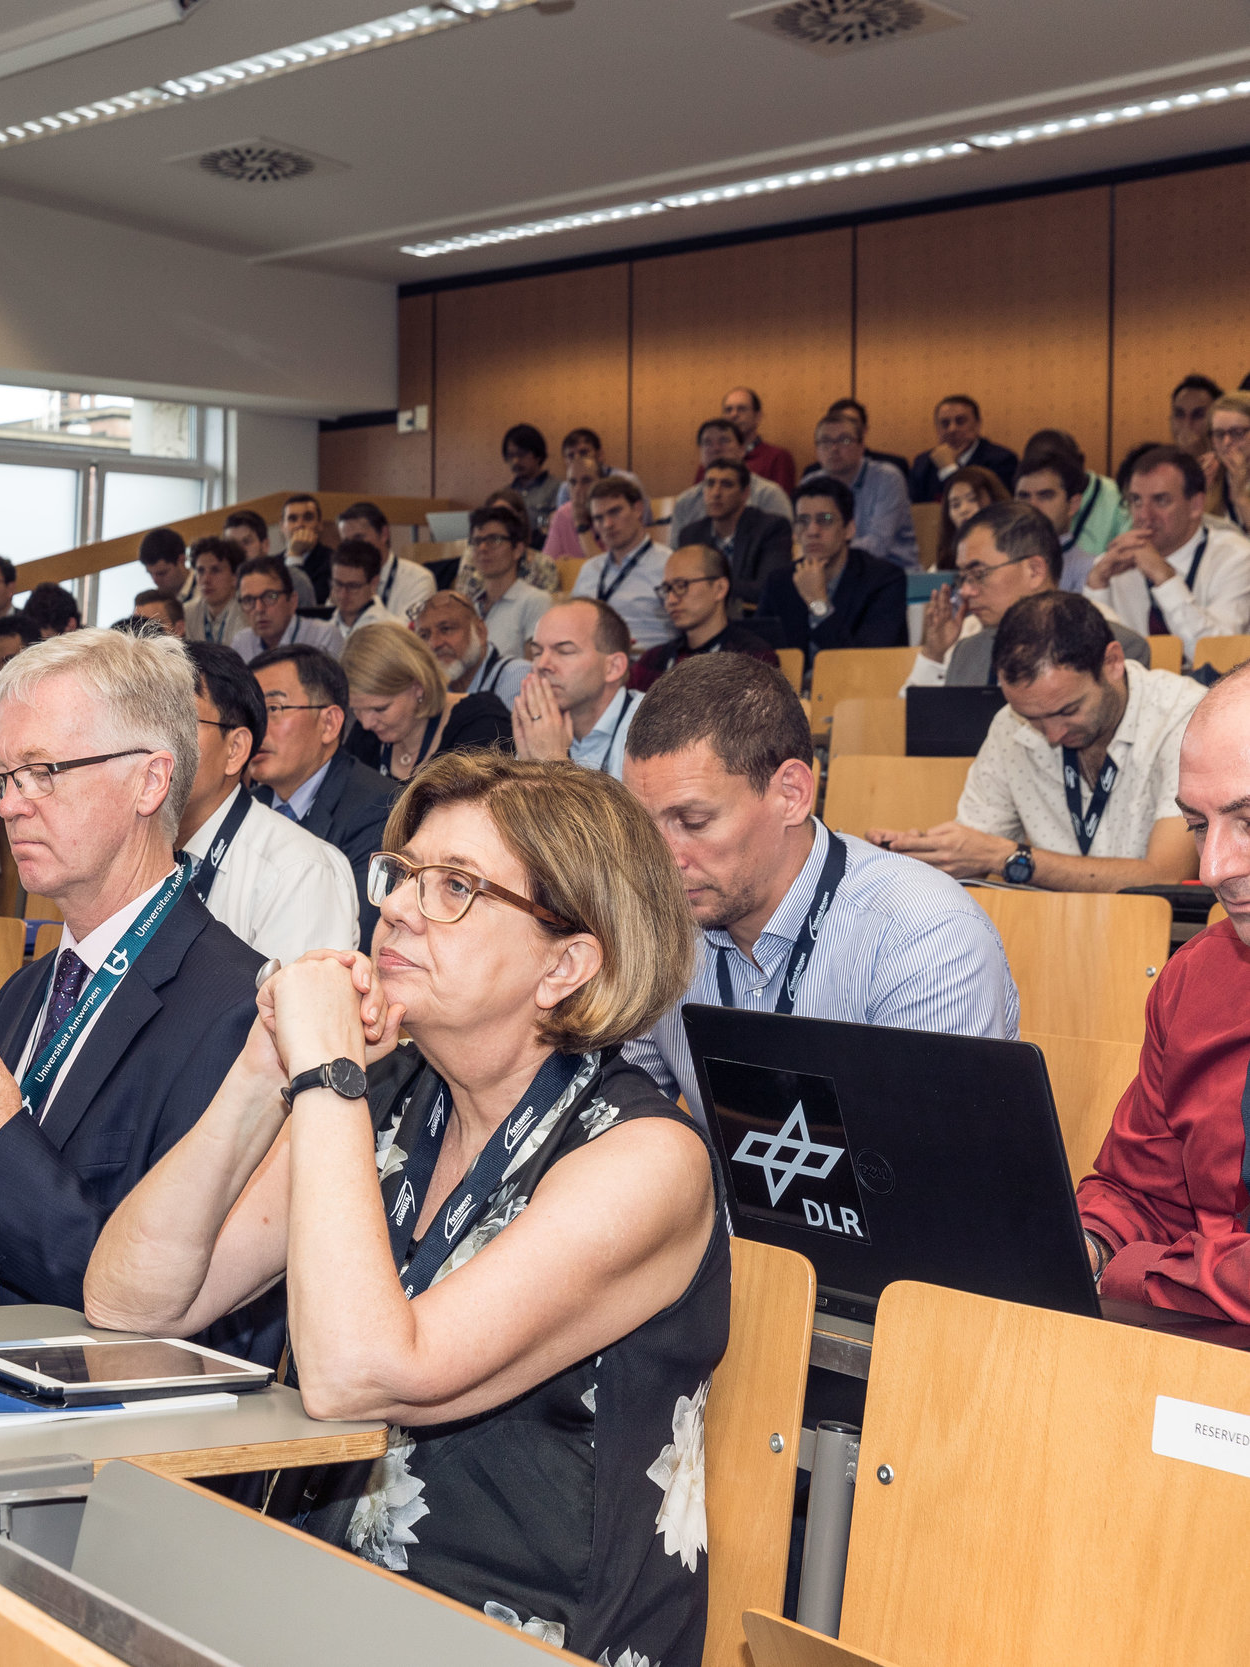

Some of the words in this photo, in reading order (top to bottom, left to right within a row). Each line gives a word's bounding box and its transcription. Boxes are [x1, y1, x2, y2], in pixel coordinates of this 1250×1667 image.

[135, 889, 175, 937] Universiteit
[35, 1032, 72, 1083] Universiteit
[67, 986, 102, 1035] Antwerpen
[430, 1107, 442, 1137] Antwerp
[509, 1106, 533, 1136] Antwerp
[396, 1193, 412, 1226] Antwerp
[449, 1194, 472, 1225] Antwerp
[802, 1199, 863, 1237] DLR
[1195, 1423, 1250, 1446] RESERVED
